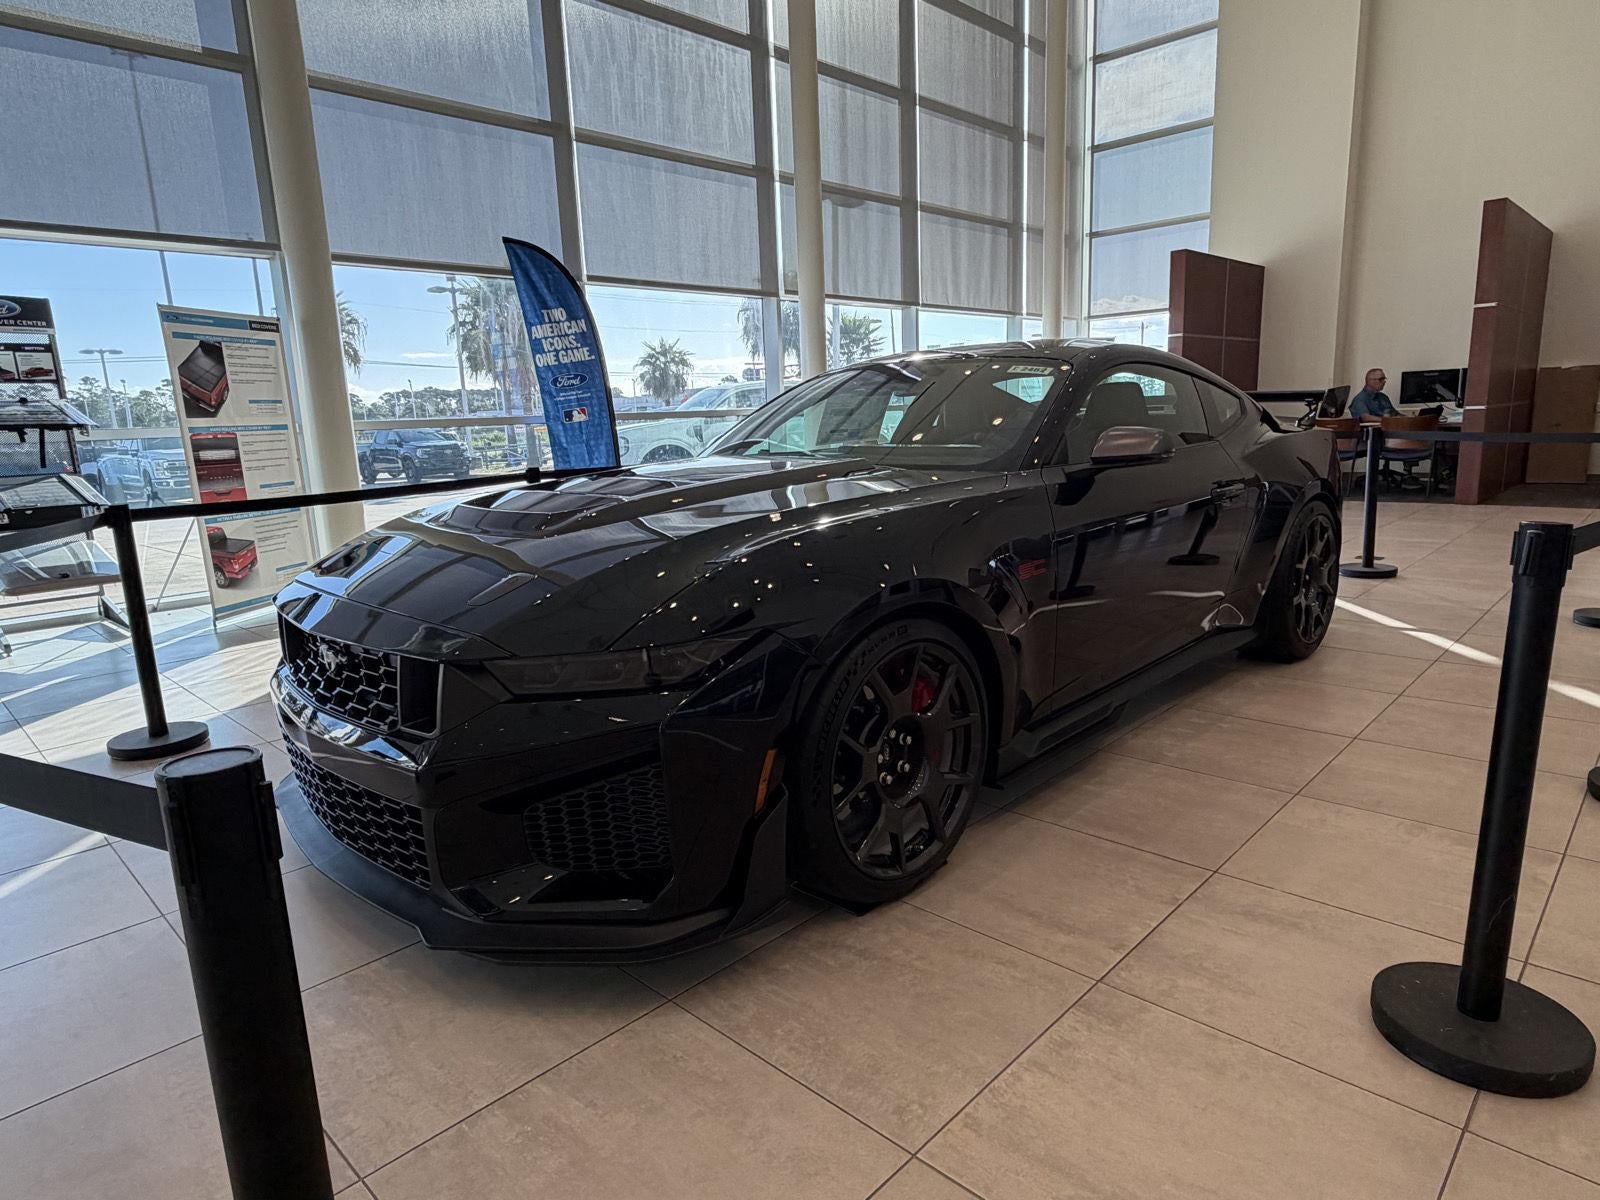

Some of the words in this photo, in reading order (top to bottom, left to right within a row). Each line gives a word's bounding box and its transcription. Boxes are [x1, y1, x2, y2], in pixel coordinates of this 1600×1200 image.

[541, 308, 567, 322] TWO
[16, 319, 47, 327] CENTER
[531, 319, 587, 339] AMERICAN
[542, 336, 580, 352] ICONS.
[536, 353, 558, 367] ONE
[559, 347, 595, 363] GAME.
[557, 375, 581, 387] Ford
